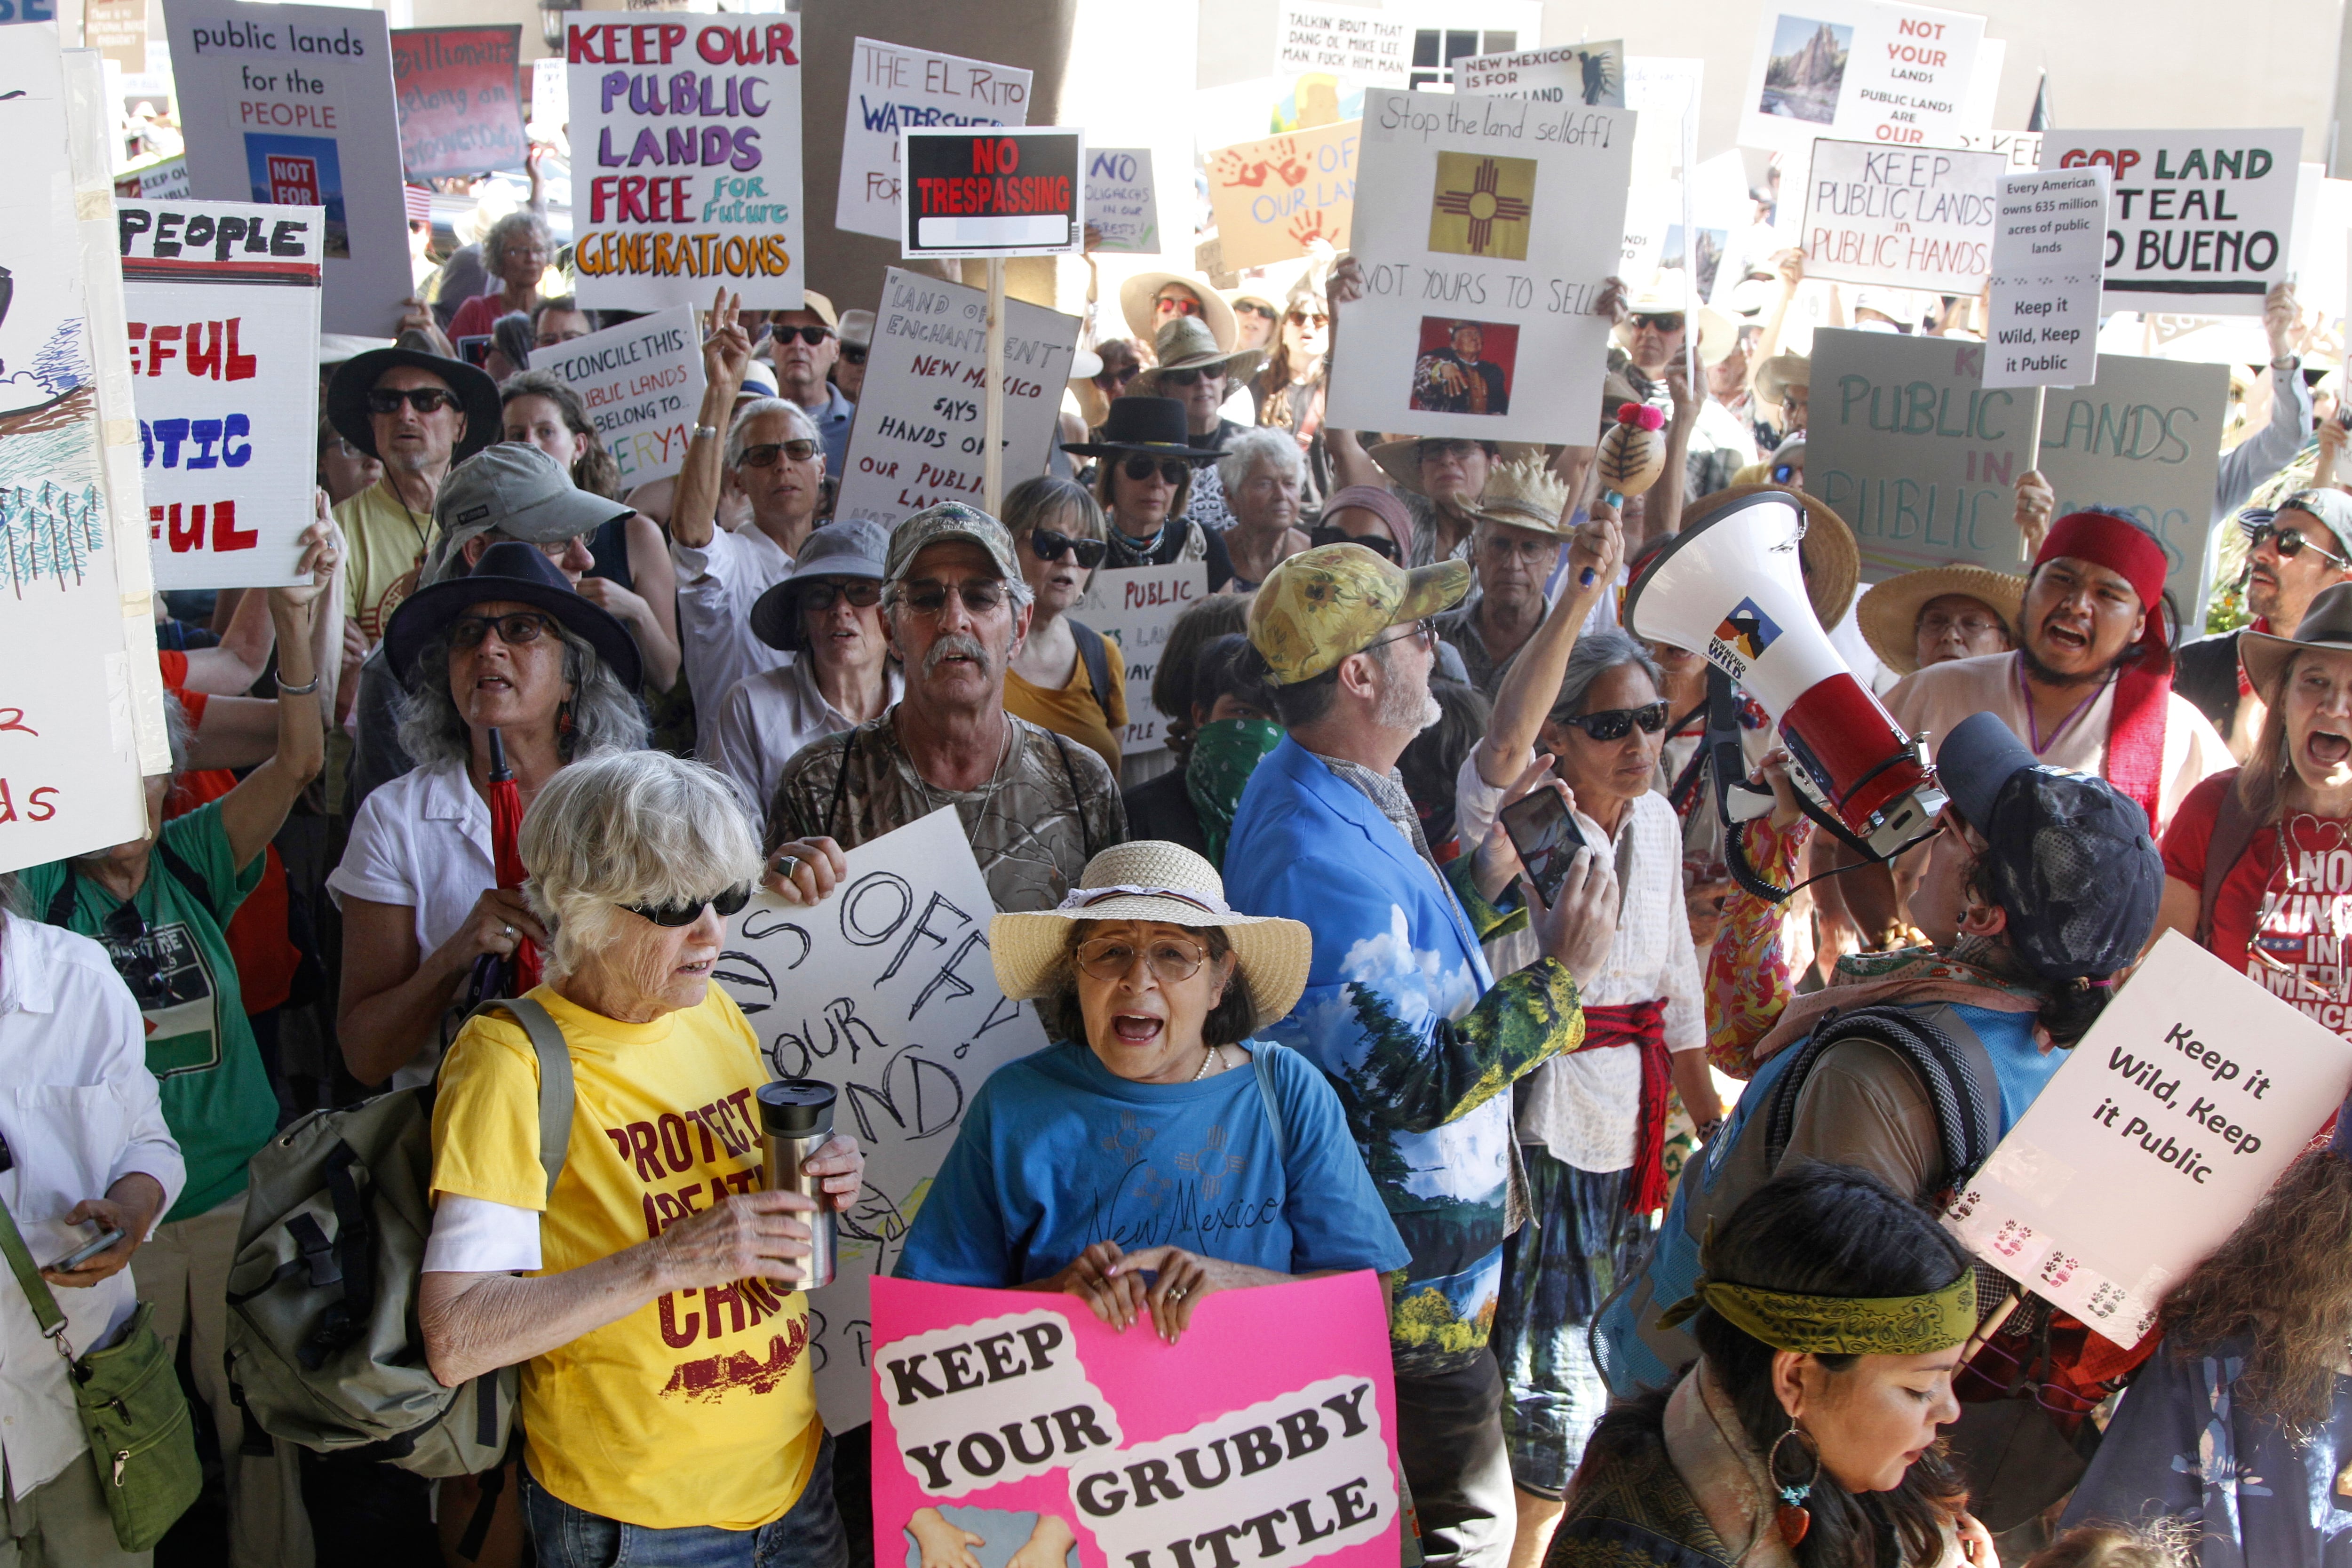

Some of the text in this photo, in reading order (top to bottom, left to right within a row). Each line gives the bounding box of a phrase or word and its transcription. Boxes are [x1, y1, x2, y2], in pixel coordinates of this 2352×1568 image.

[193, 21, 364, 56] public lands
[568, 23, 799, 66] KEEP OUR
[1289, 31, 1321, 46] DANG
[1374, 23, 1403, 37] THAT
[1900, 18, 1946, 40] NOT
[1318, 51, 1346, 66] FUCK
[1466, 49, 1573, 72] NEW MEXICO
[1887, 43, 1947, 68] YOUR
[243, 66, 324, 95] for the
[859, 45, 1025, 105] THE EL RITO
[1466, 72, 1518, 88] IS FOR
[1891, 67, 1934, 84] LANDS
[602, 70, 771, 118] PUBLIC
[1860, 88, 1954, 114] PUBLIC LANDS
[240, 101, 337, 129] PEOPLE
[1380, 96, 1440, 143] Stop
[1448, 99, 1479, 135] the
[1484, 103, 1528, 139] land
[1891, 110, 1917, 125] ARE
[598, 125, 763, 172] LANDS
[1875, 124, 1924, 144] OUR
[273, 162, 310, 183] NOT
[973, 138, 1019, 174] NO
[1091, 151, 1137, 183] NO
[1864, 152, 1951, 189] KEEP
[2060, 149, 2273, 181] GOP LAND
[278, 186, 312, 205] FOR
[590, 175, 769, 224] FREE FOR
[917, 175, 1070, 214] TRESPASSING
[1085, 184, 1150, 202] OLIGARCHS
[2007, 177, 2096, 197] Every American
[702, 199, 788, 224] Future
[1103, 205, 1143, 215] IN OUR
[1252, 188, 1306, 224] OUR
[1816, 182, 1995, 227] PUBLIC LANDS
[2002, 197, 2098, 216] owns 635 million
[2116, 189, 2238, 221] TEAL
[119, 209, 309, 262] PEOPLE
[1895, 221, 1911, 234] in
[2008, 219, 2090, 236] acres of public
[575, 230, 790, 278] GENERATIONS
[1812, 228, 1987, 275] PUBLIC HANDS
[2032, 241, 2062, 255] lands
[2104, 230, 2279, 273] O BUENO
[1357, 263, 1597, 316] NOT YOURS TO SELL
[2015, 298, 2068, 317] Keep it
[887, 314, 1074, 369] ENCHANTENT"
[1998, 327, 2081, 345] Wild, Keep
[553, 342, 641, 382] ECONCILE
[911, 355, 962, 378] NEW
[2006, 355, 2068, 373] it Public
[581, 364, 687, 410] UBLIC LANDS
[594, 401, 656, 434] BELONG
[933, 397, 977, 422] SAYS
[1839, 374, 2013, 442] PUBLIC
[878, 416, 947, 448] HANDS
[859, 457, 986, 494] OUR PUBLI
[1966, 451, 2013, 486] IN
[898, 489, 960, 510] LA
[1822, 470, 2000, 551] PUBLIC
[1125, 580, 1193, 610] PUBLIC
[1708, 642, 1741, 679] WILD
[1711, 637, 1727, 652] NEW
[1724, 648, 1746, 672] MEXICO
[1124, 722, 1154, 743] PLE
[2298, 850, 2352, 893] NO
[2307, 935, 2340, 964] IN
[772, 996, 889, 1081] OUR
[2163, 1022, 2272, 1101] Keep it
[846, 1044, 963, 1144] ND
[2107, 1045, 2262, 1155] Wild, Keep
[606, 1087, 763, 1183] PROTECT
[2092, 1097, 2213, 1185] it Public
[1086, 1159, 1285, 1257] New Mexico
[887, 1322, 1063, 1406] KEEP
[905, 1404, 1112, 1490] YOUR
[1076, 1382, 1370, 1517] GRUBBY
